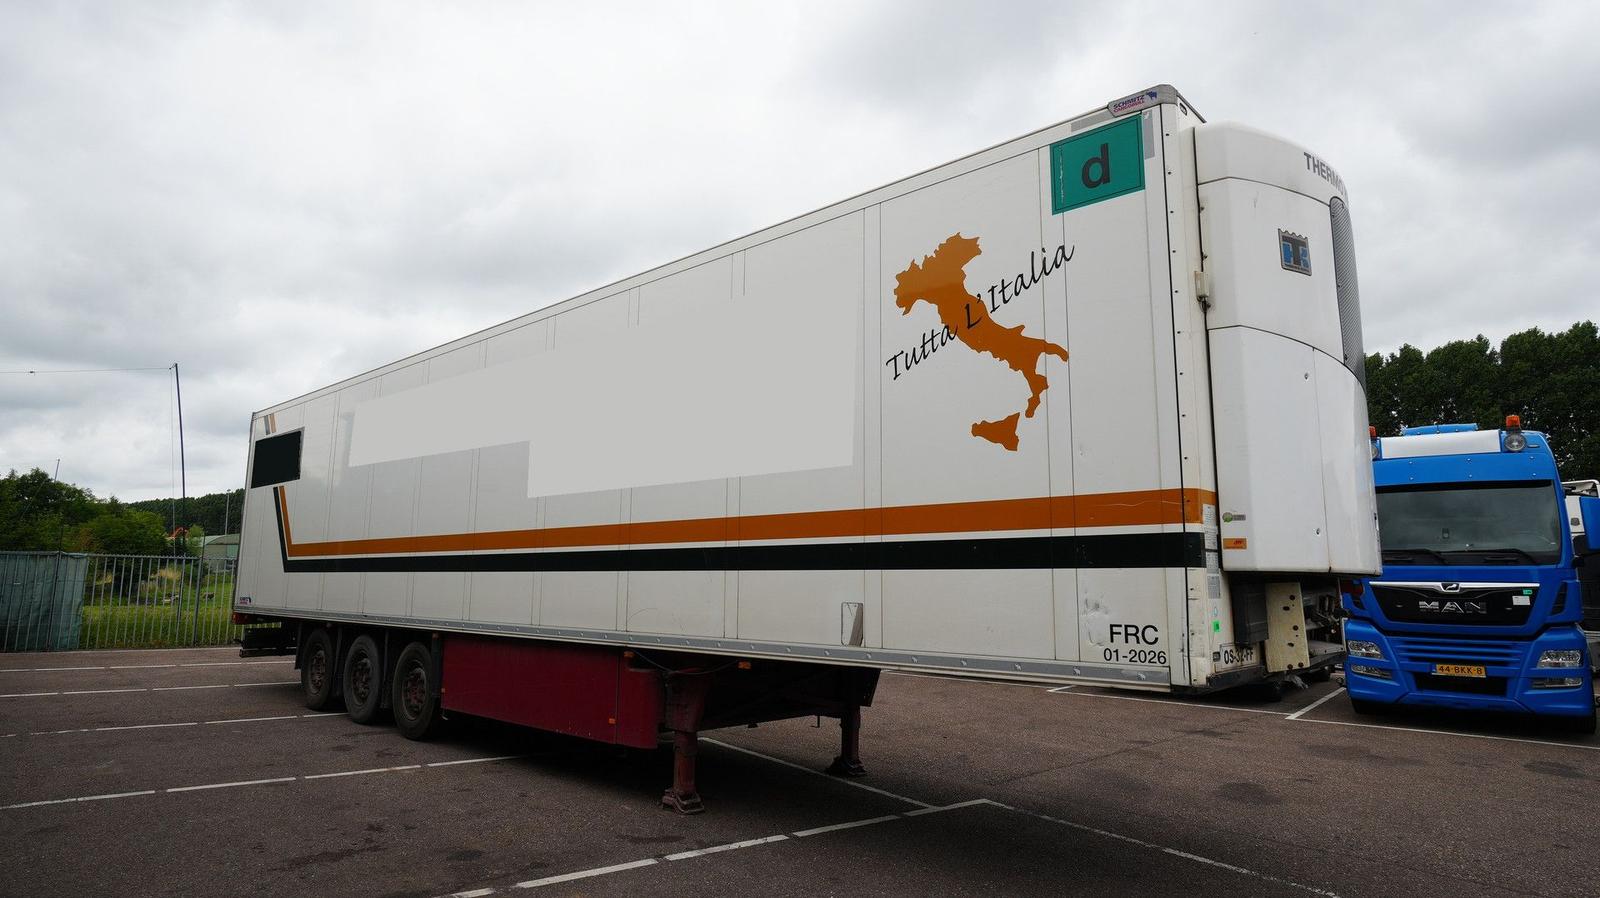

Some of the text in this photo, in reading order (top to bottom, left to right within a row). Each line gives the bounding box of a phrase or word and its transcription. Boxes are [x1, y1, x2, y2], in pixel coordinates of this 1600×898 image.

[1113, 94, 1145, 109] SCHMITZ
[1081, 143, 1111, 189] d
[885, 323, 959, 381] Tutta
[1418, 600, 1487, 614] MAN
[1109, 623, 1159, 645] FRC
[1103, 647, 1167, 665] 01-2026
[1438, 665, 1483, 675] 44-BKK-8
